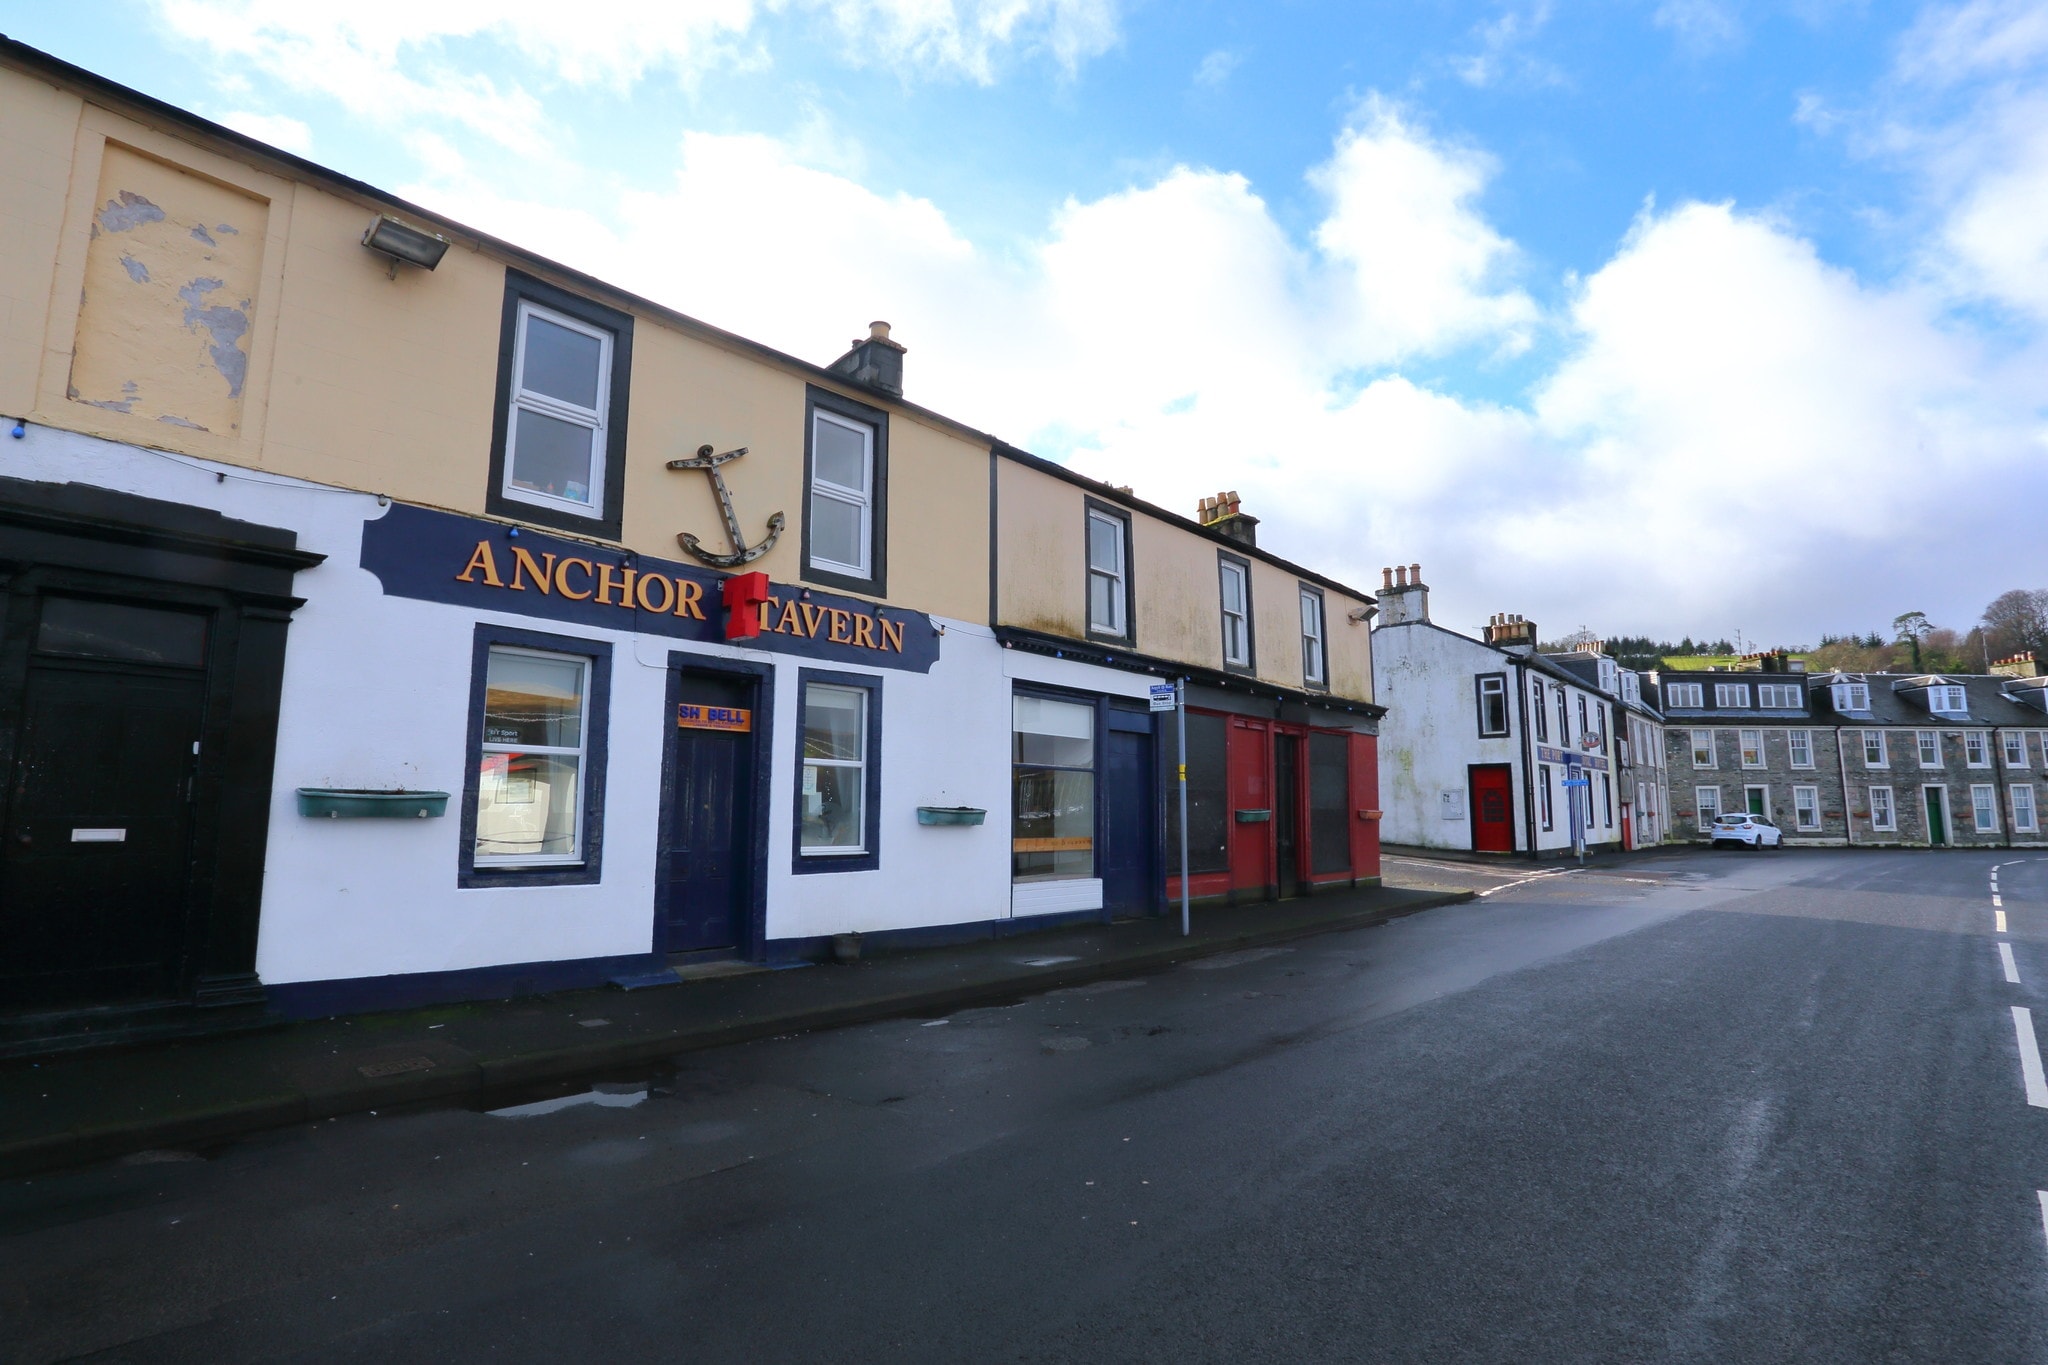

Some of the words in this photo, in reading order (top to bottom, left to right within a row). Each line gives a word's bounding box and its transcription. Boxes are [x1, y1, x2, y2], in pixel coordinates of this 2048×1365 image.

[456, 539, 706, 621] ANCHOR
[760, 596, 905, 653] TAVERN
[680, 706, 700, 719] SH
[708, 708, 744, 722] BELL
